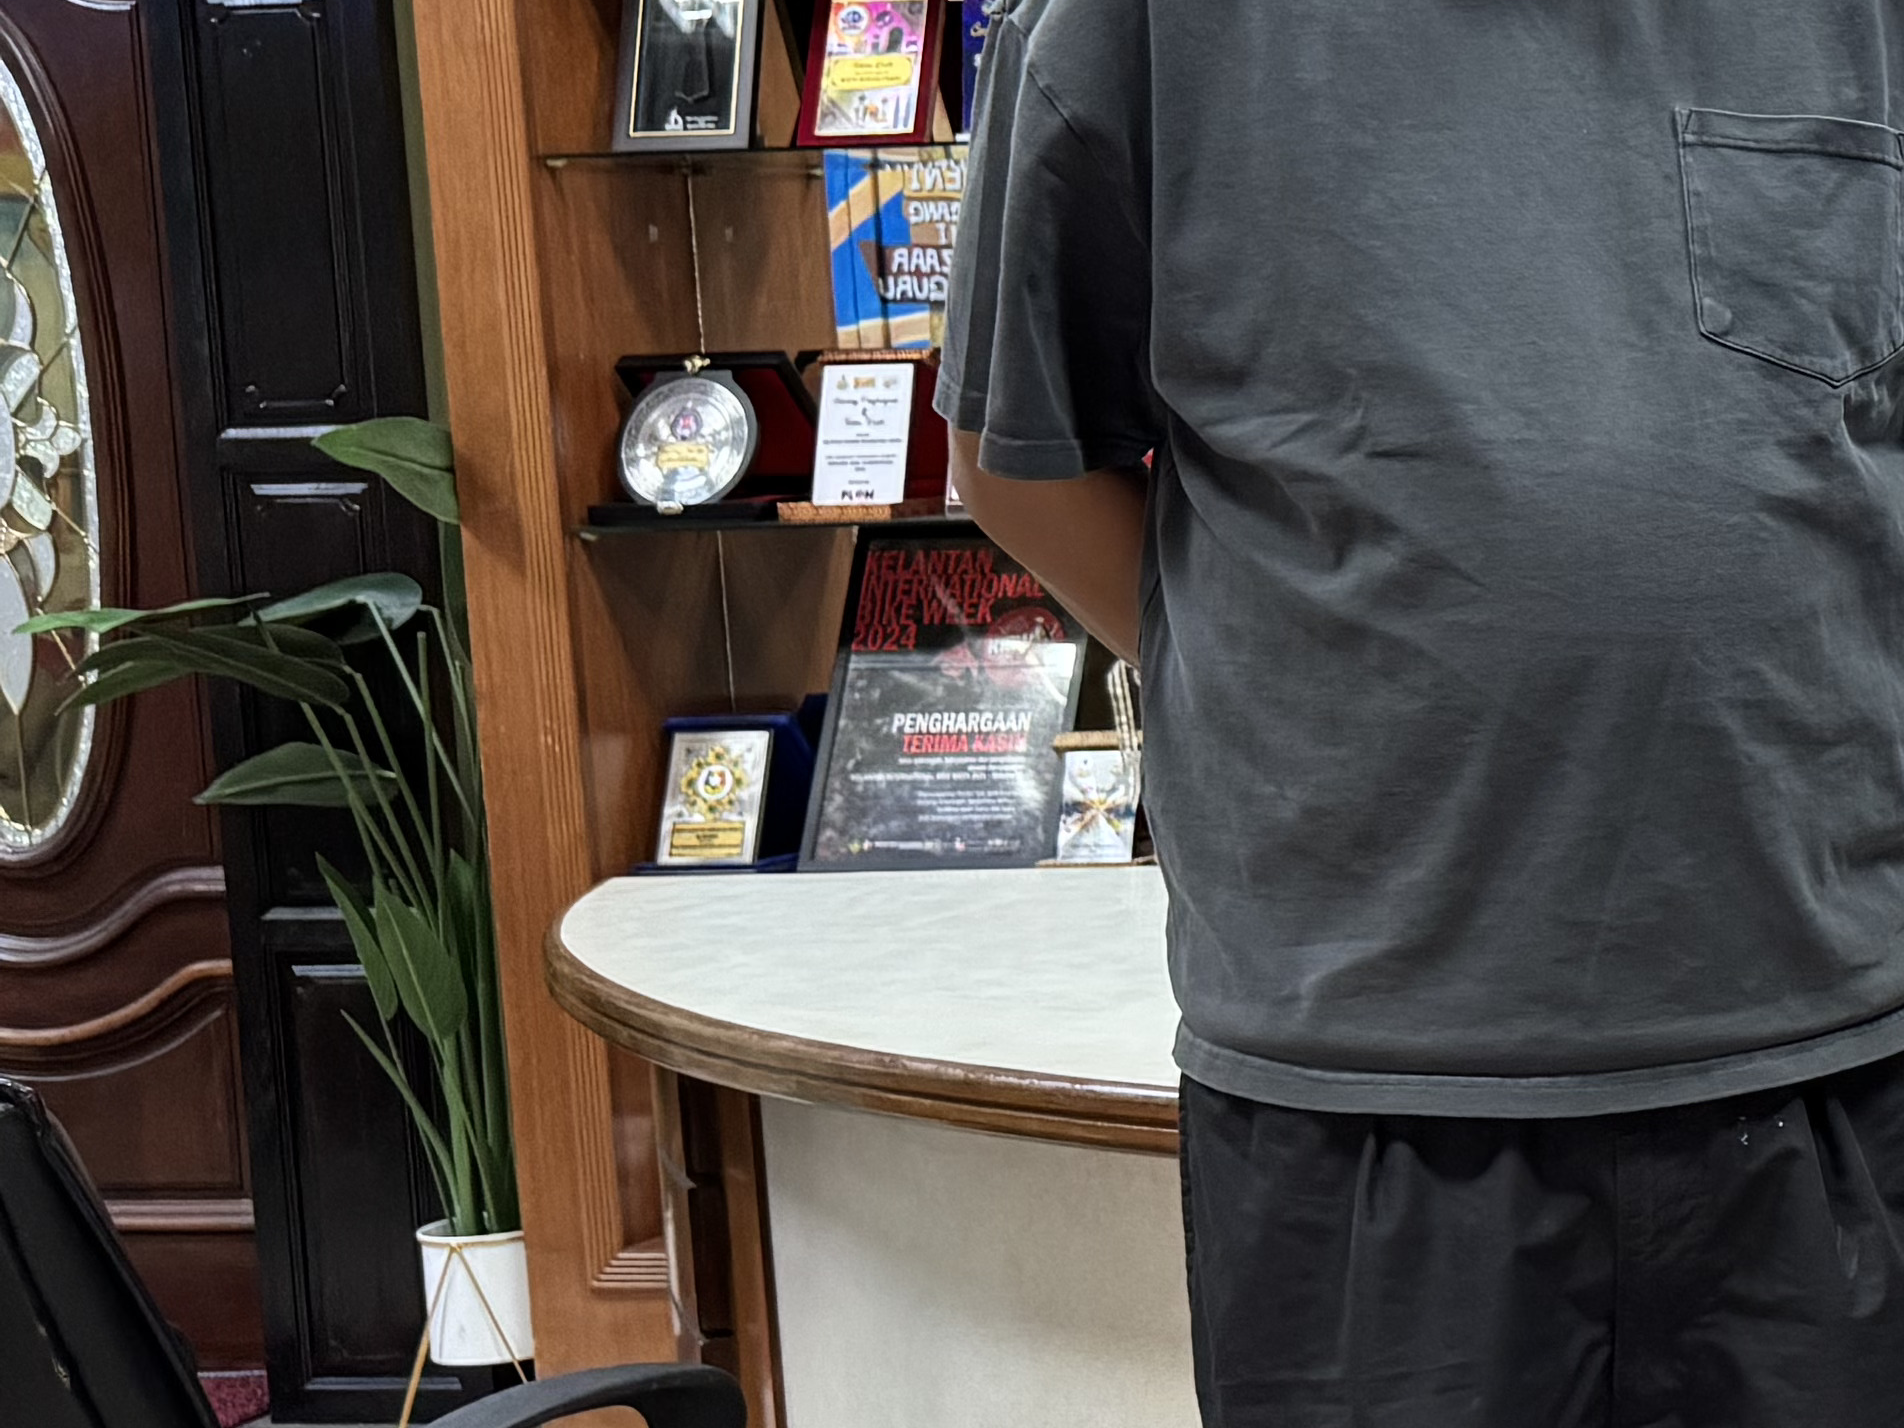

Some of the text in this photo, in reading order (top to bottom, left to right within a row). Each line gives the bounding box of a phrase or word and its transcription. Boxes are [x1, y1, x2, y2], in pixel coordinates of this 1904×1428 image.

[865, 549, 994, 575] KELANTAN
[861, 572, 1045, 604] INTERNATIONAL
[857, 597, 994, 625] BIKE WEEK
[851, 623, 918, 651] 2024
[892, 712, 1032, 733] PENGHARGAAN
[903, 733, 1028, 753] TERIMA KASIH
